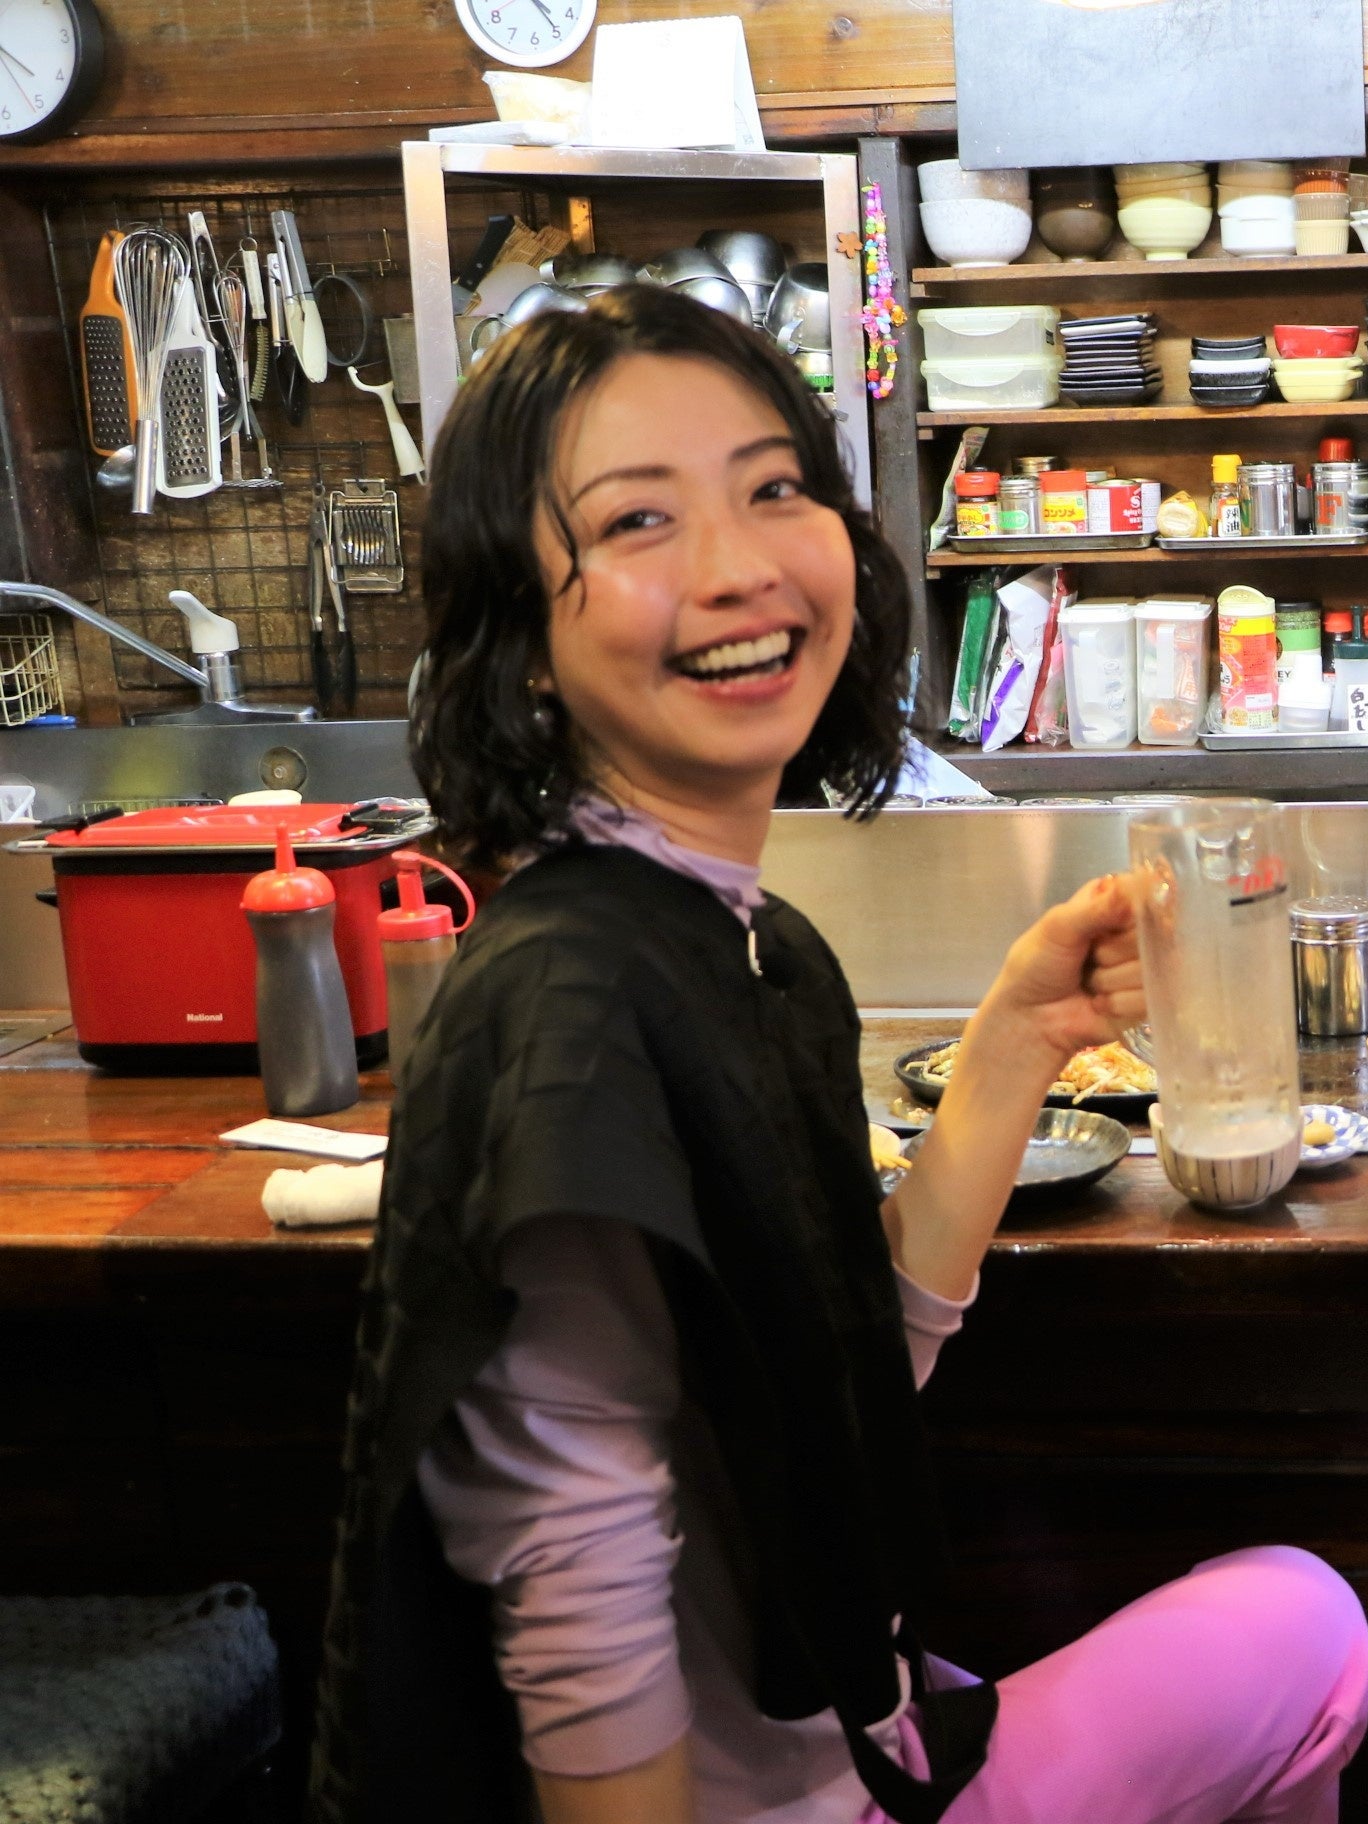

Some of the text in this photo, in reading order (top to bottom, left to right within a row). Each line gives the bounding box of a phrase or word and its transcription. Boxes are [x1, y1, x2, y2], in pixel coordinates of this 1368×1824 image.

[491, 10, 501, 23] 8
[565, 7, 574, 19] 4
[60, 29, 69, 43] 3
[508, 27, 517, 40] 7
[530, 32, 539, 45] 6
[552, 26, 561, 38] 5
[56, 68, 64, 80] 4
[35, 94, 44, 108] 5
[1, 105, 10, 119] 6
[1044, 508, 1076, 518] コンソメ
[1317, 494, 1342, 525] F
[187, 1013, 223, 1021] National
